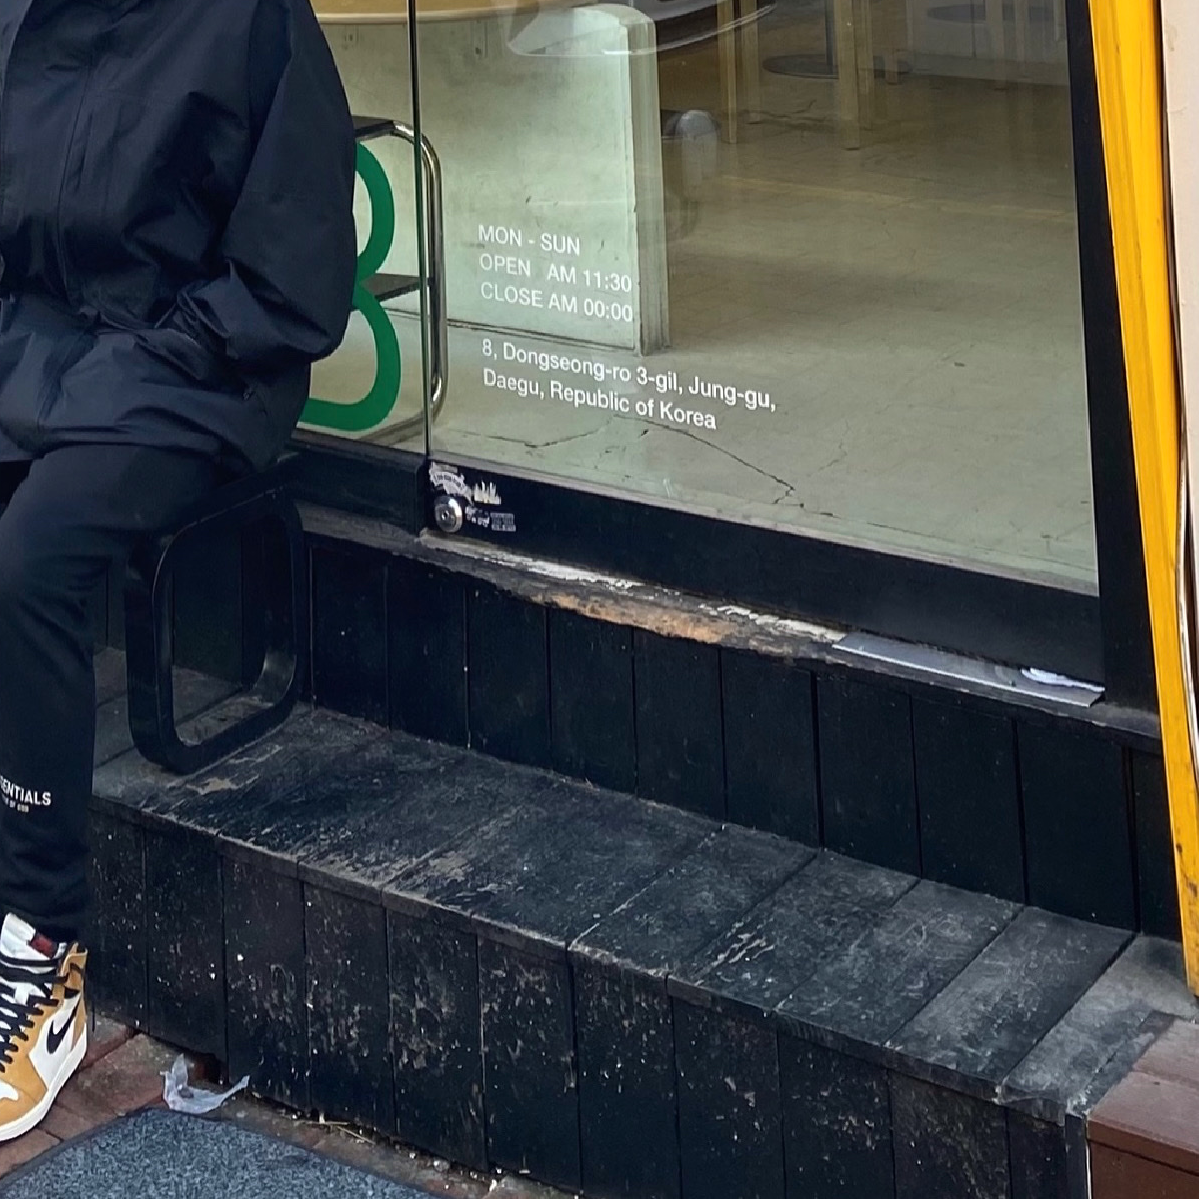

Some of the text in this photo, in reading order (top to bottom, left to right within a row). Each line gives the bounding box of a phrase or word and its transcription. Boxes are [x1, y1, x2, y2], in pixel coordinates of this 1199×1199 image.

[478, 224, 523, 247] MON
[541, 233, 580, 256] SUN
[479, 253, 632, 292] OPEN AM 11:30
[481, 282, 633, 322] CLOSE AM 00:00
[482, 339, 777, 412] 8, Dongseong-ro 3-gil, Jung-gu,
[483, 368, 717, 429] Daegu, Republic of Korea
